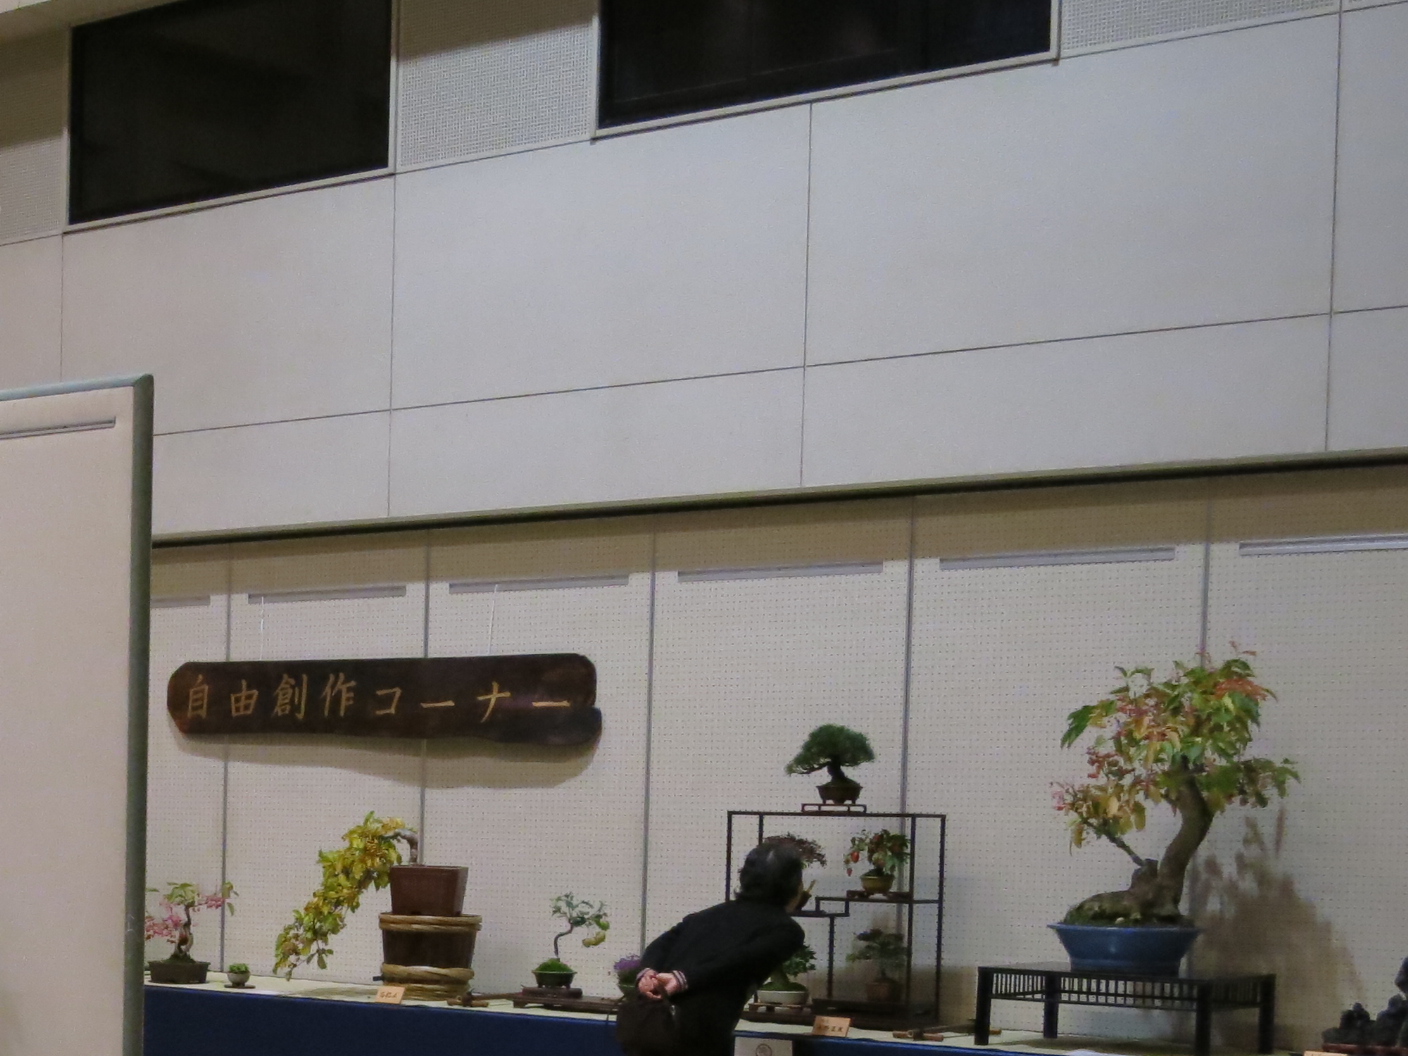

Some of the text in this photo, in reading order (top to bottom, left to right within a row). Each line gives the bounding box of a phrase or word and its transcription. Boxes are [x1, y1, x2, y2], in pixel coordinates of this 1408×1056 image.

[186, 672, 571, 723] 自由創作コーナー
